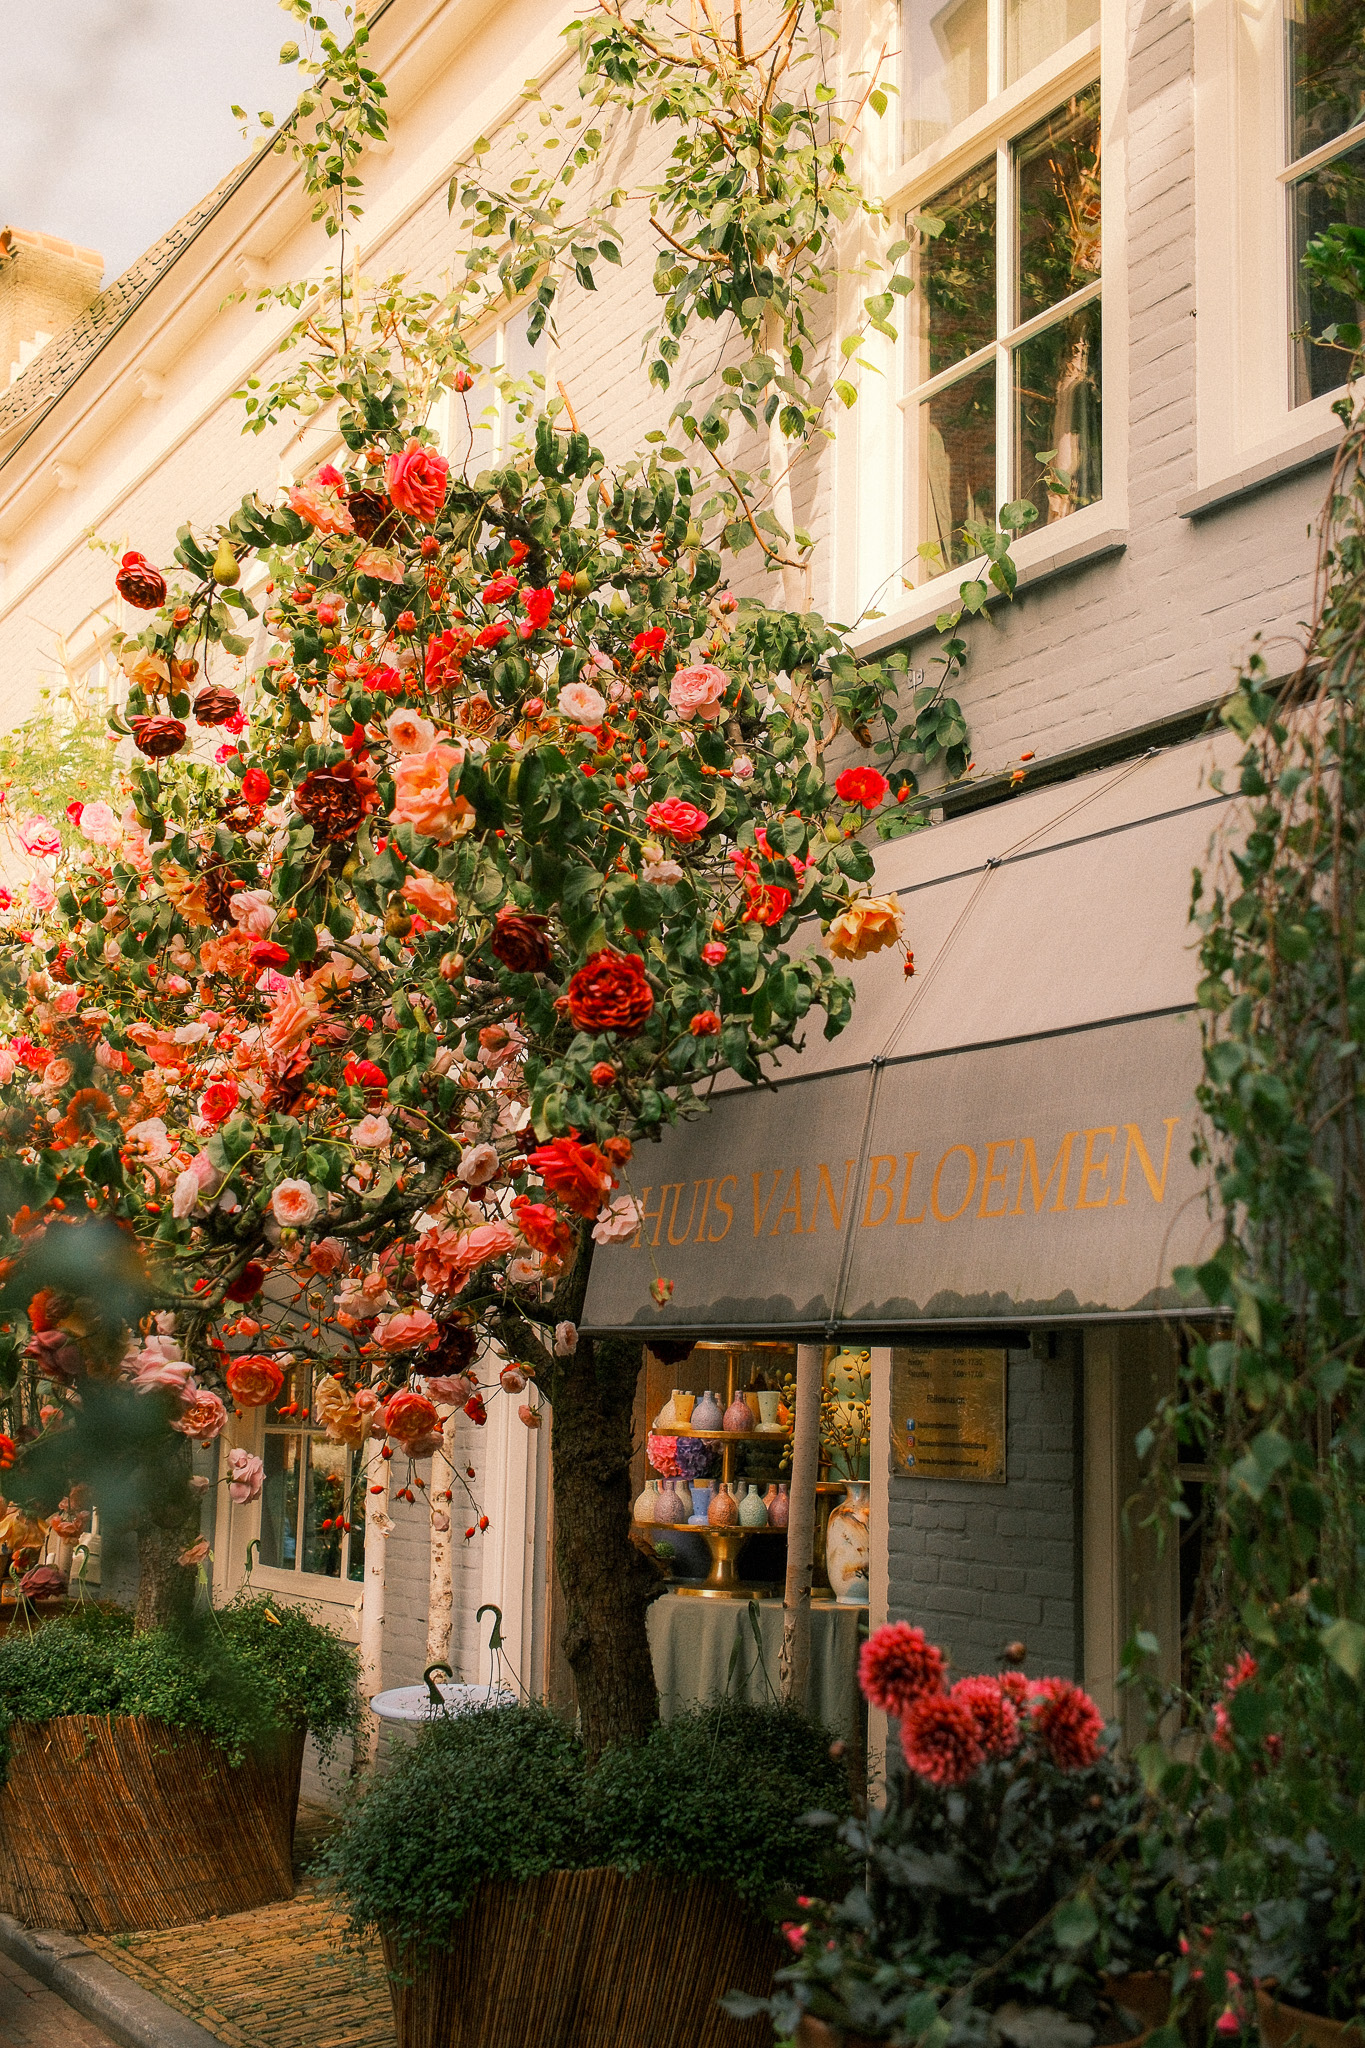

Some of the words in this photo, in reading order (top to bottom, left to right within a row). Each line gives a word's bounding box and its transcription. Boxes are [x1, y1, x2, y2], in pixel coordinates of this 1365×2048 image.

[630, 1174, 739, 1248] HUIS
[751, 1160, 857, 1238] VAN
[860, 1117, 1181, 1228] BLOEMEN
